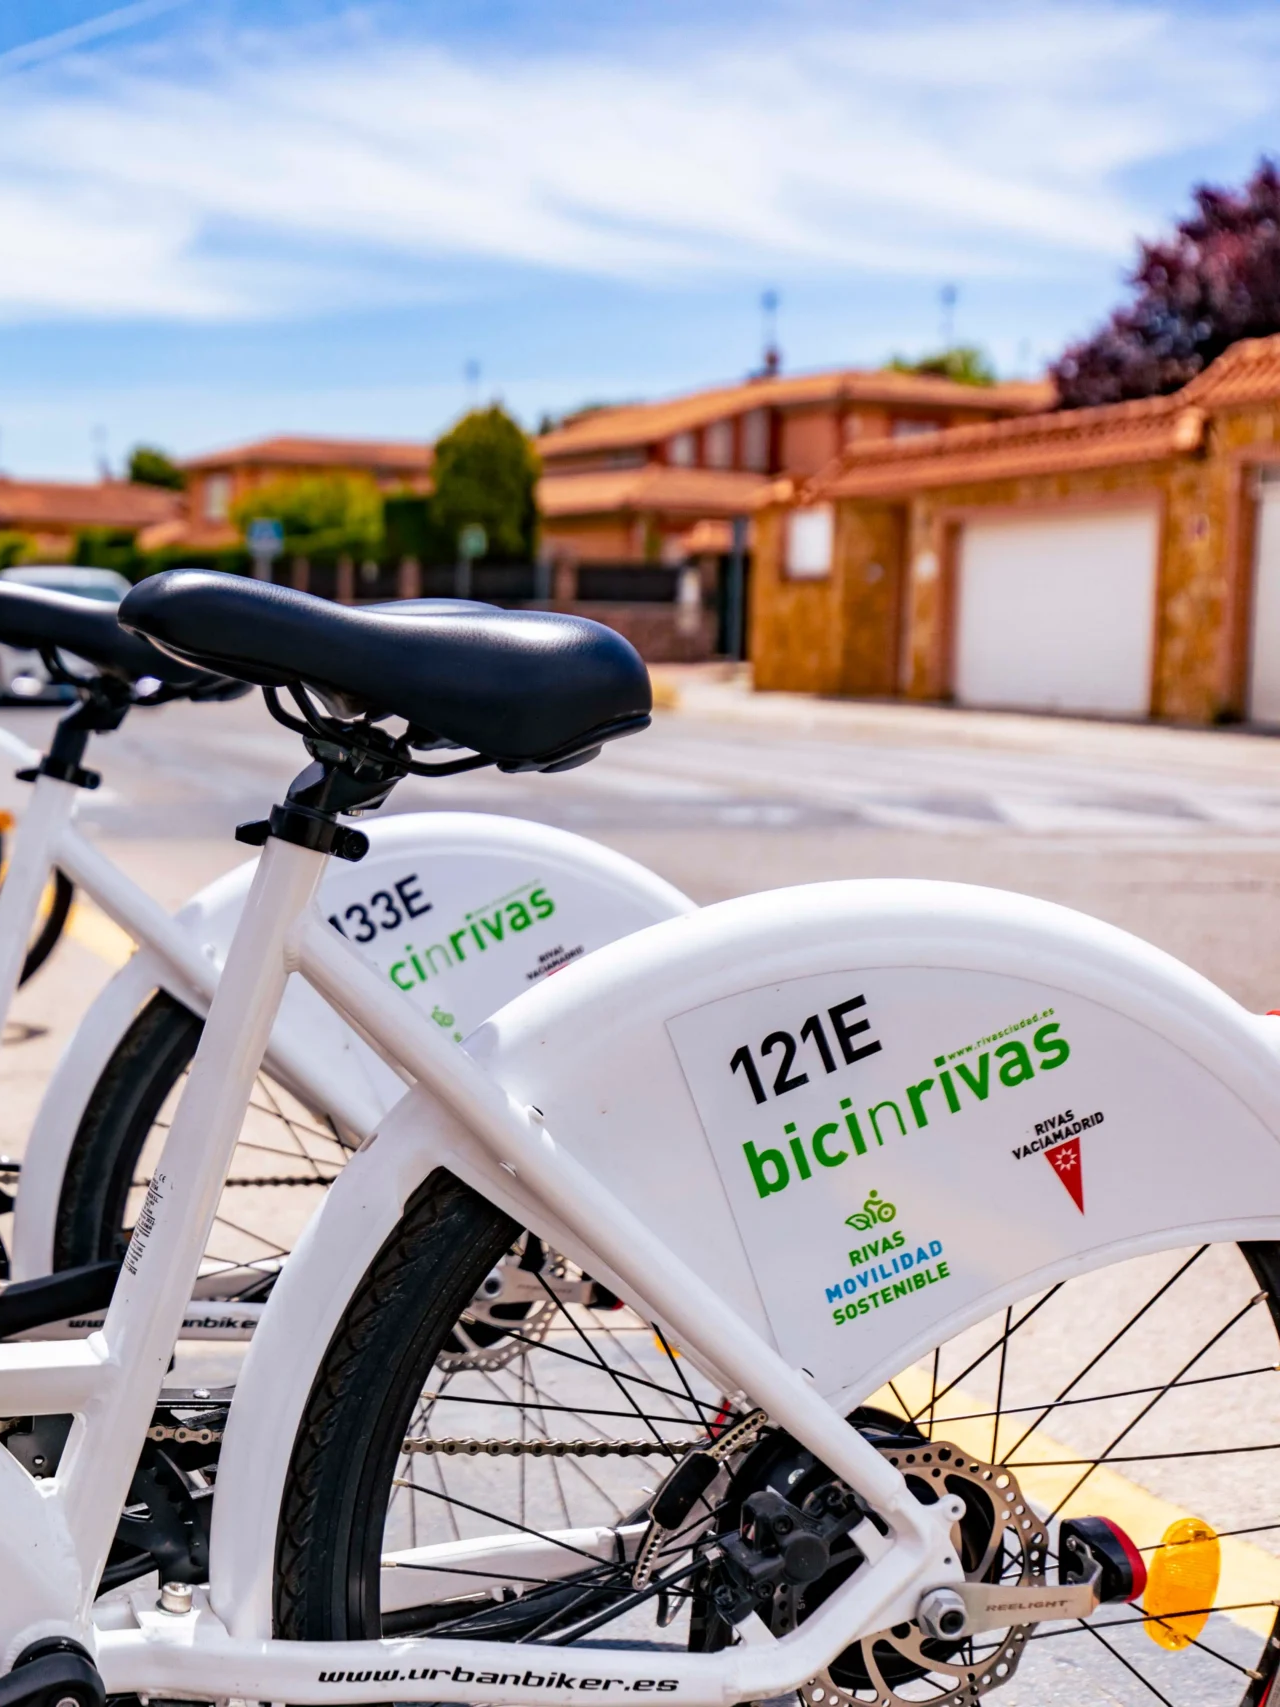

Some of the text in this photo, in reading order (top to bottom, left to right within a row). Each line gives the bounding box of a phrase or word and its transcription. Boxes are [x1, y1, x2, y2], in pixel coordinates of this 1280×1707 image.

[730, 994, 883, 1105] 121E
[948, 1007, 1055, 1060] www.rivasciudad.es
[742, 1022, 1071, 1198] bicinrivas
[1012, 1111, 1105, 1160] VACIAMADRID
[1034, 1109, 1075, 1136] RIVAS
[825, 1239, 943, 1304] MOVILIDAD
[848, 1230, 905, 1267] RIVAS
[832, 1261, 951, 1326] SOSTENIBLE
[985, 1600, 1069, 1613] REELIGHT
[318, 1666, 680, 1693] www.urbanbiker.es
